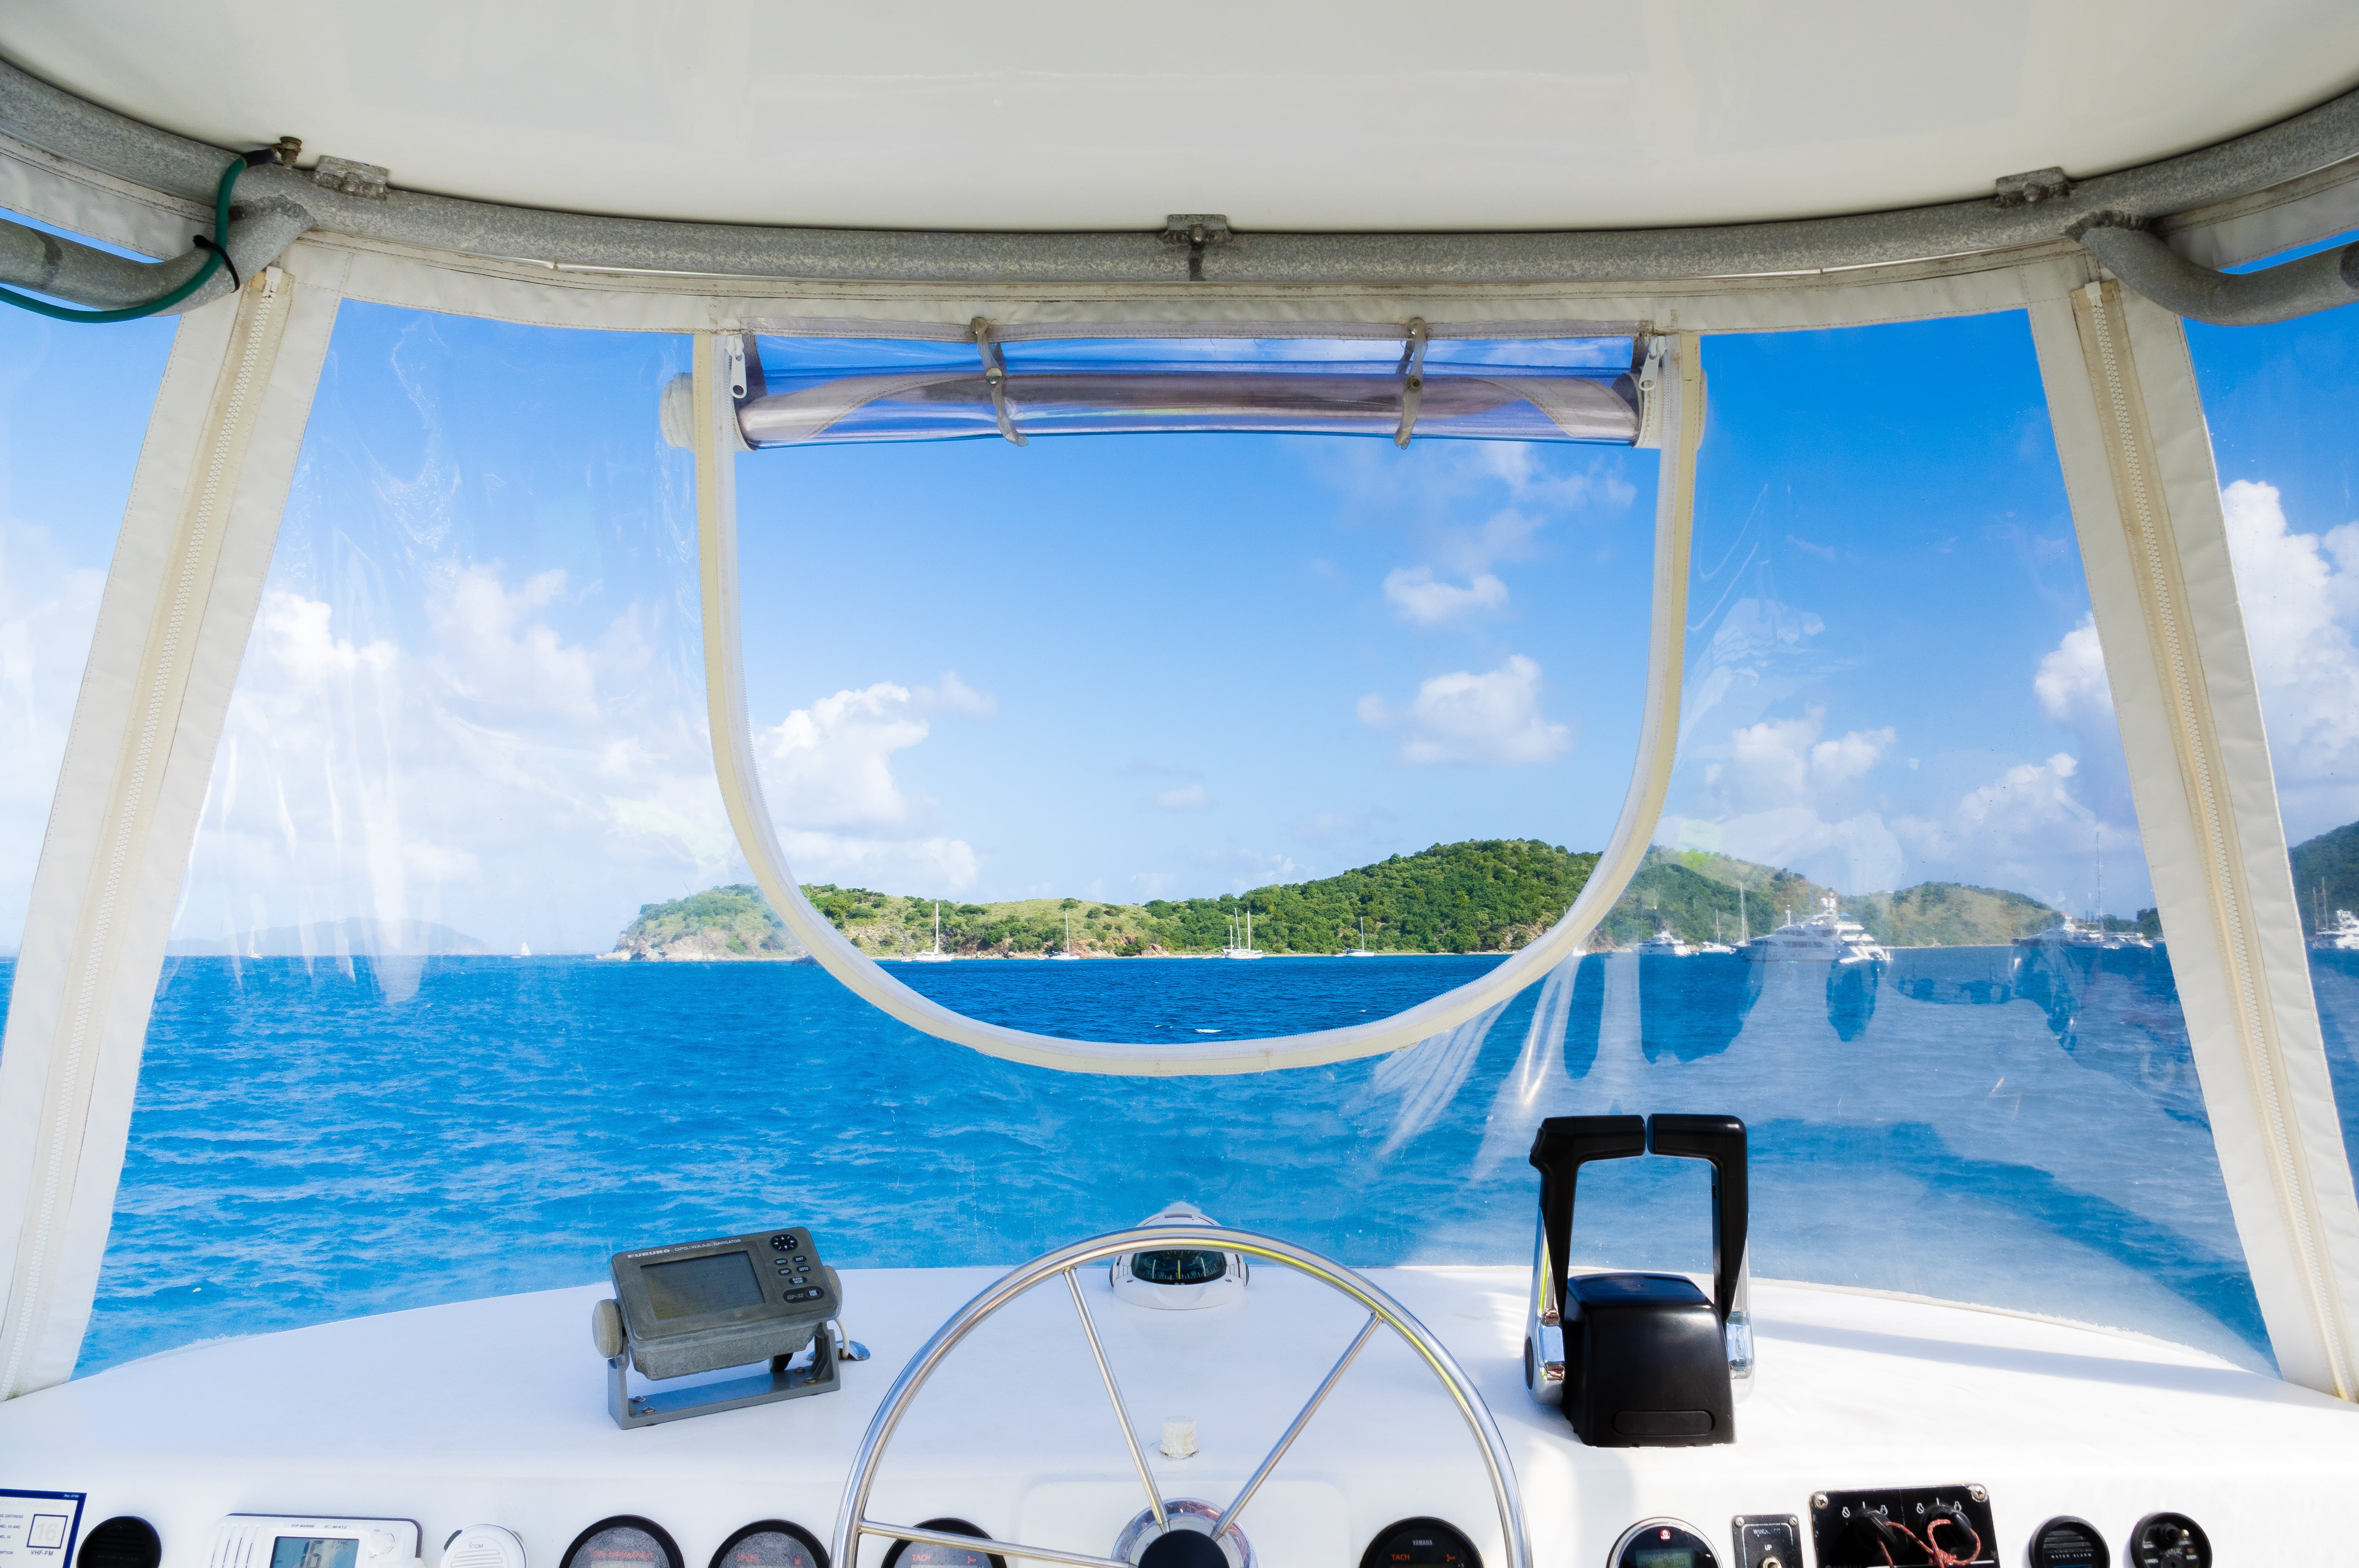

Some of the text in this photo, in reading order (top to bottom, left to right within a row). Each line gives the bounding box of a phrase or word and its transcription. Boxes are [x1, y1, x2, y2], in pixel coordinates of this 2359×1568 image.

[627, 1249, 670, 1258] FURUNO
[675, 1243, 711, 1252] GPS/WAAS
[38, 1522, 59, 1542] 16
[912, 1553, 931, 1562] TACH
